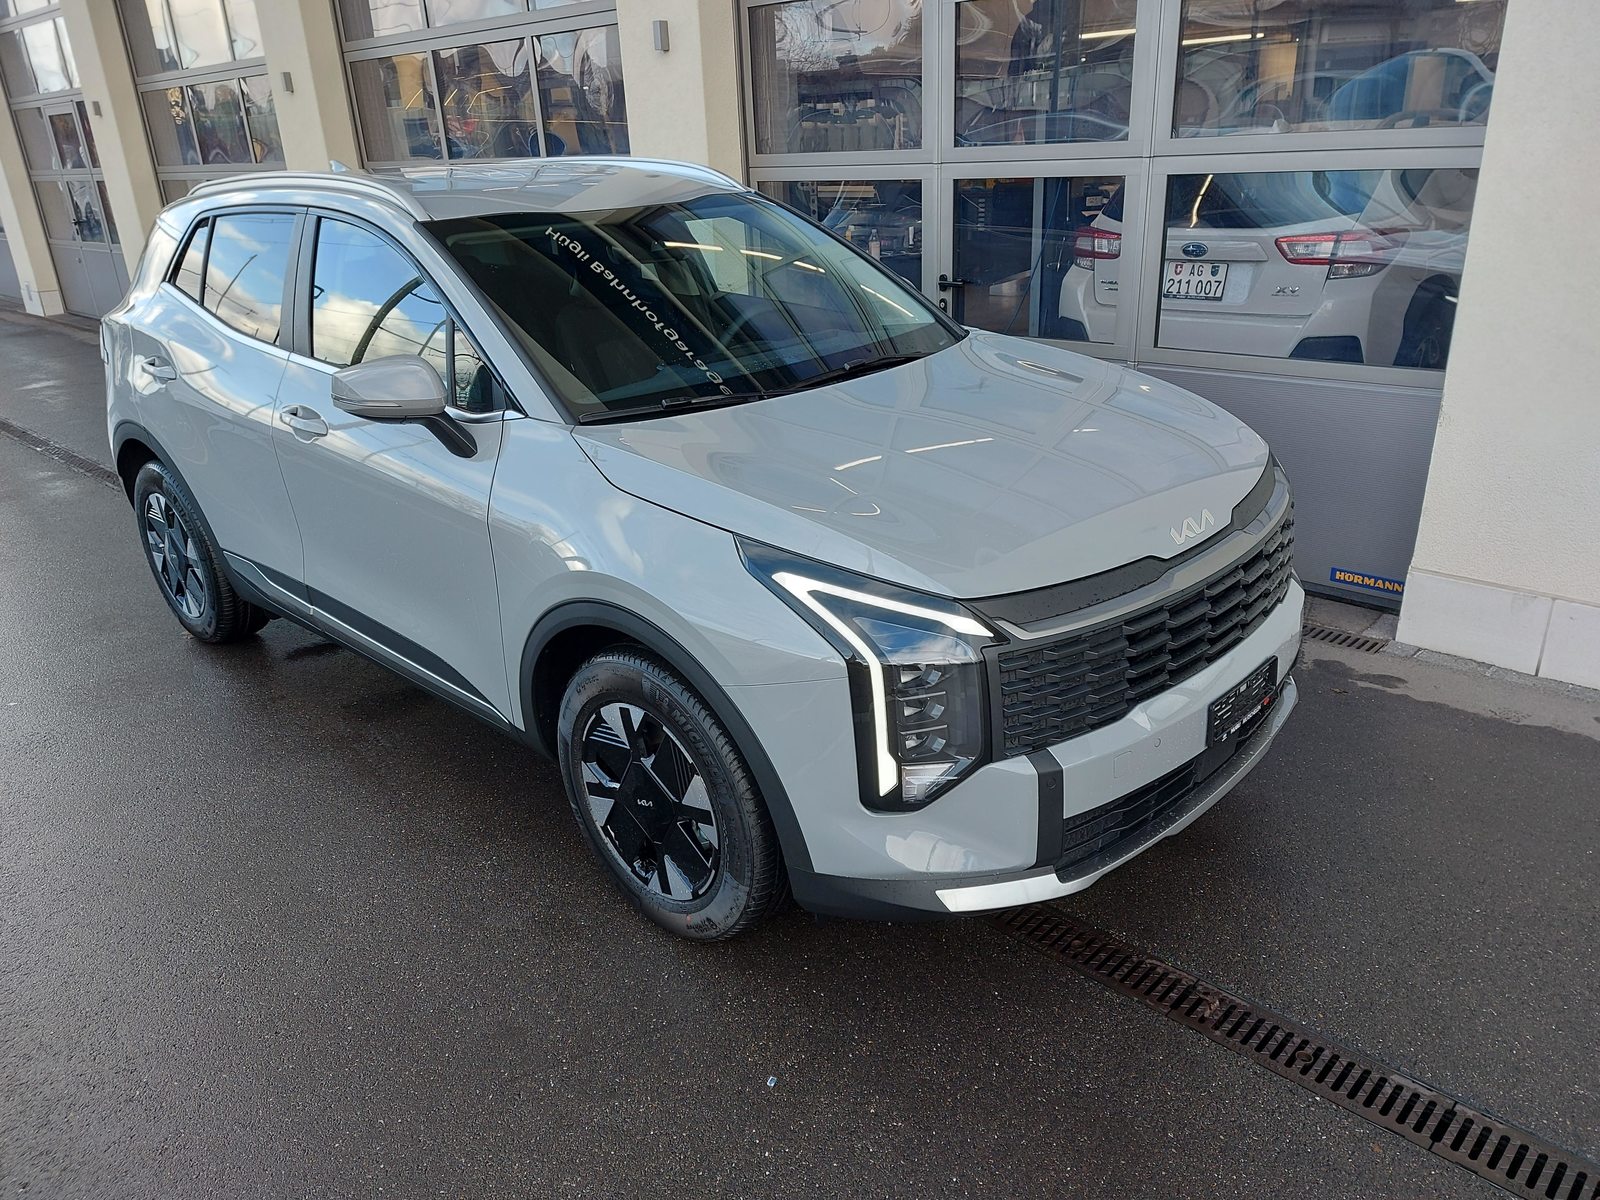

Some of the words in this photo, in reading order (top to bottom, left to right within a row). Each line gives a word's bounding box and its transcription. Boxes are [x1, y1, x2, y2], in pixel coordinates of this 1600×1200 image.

[1189, 264, 1204, 276] AG
[1166, 278, 1191, 294] 211
[1195, 280, 1222, 296] 007
[1275, 286, 1300, 294] XV
[1335, 571, 1403, 593] HÖRMANN
